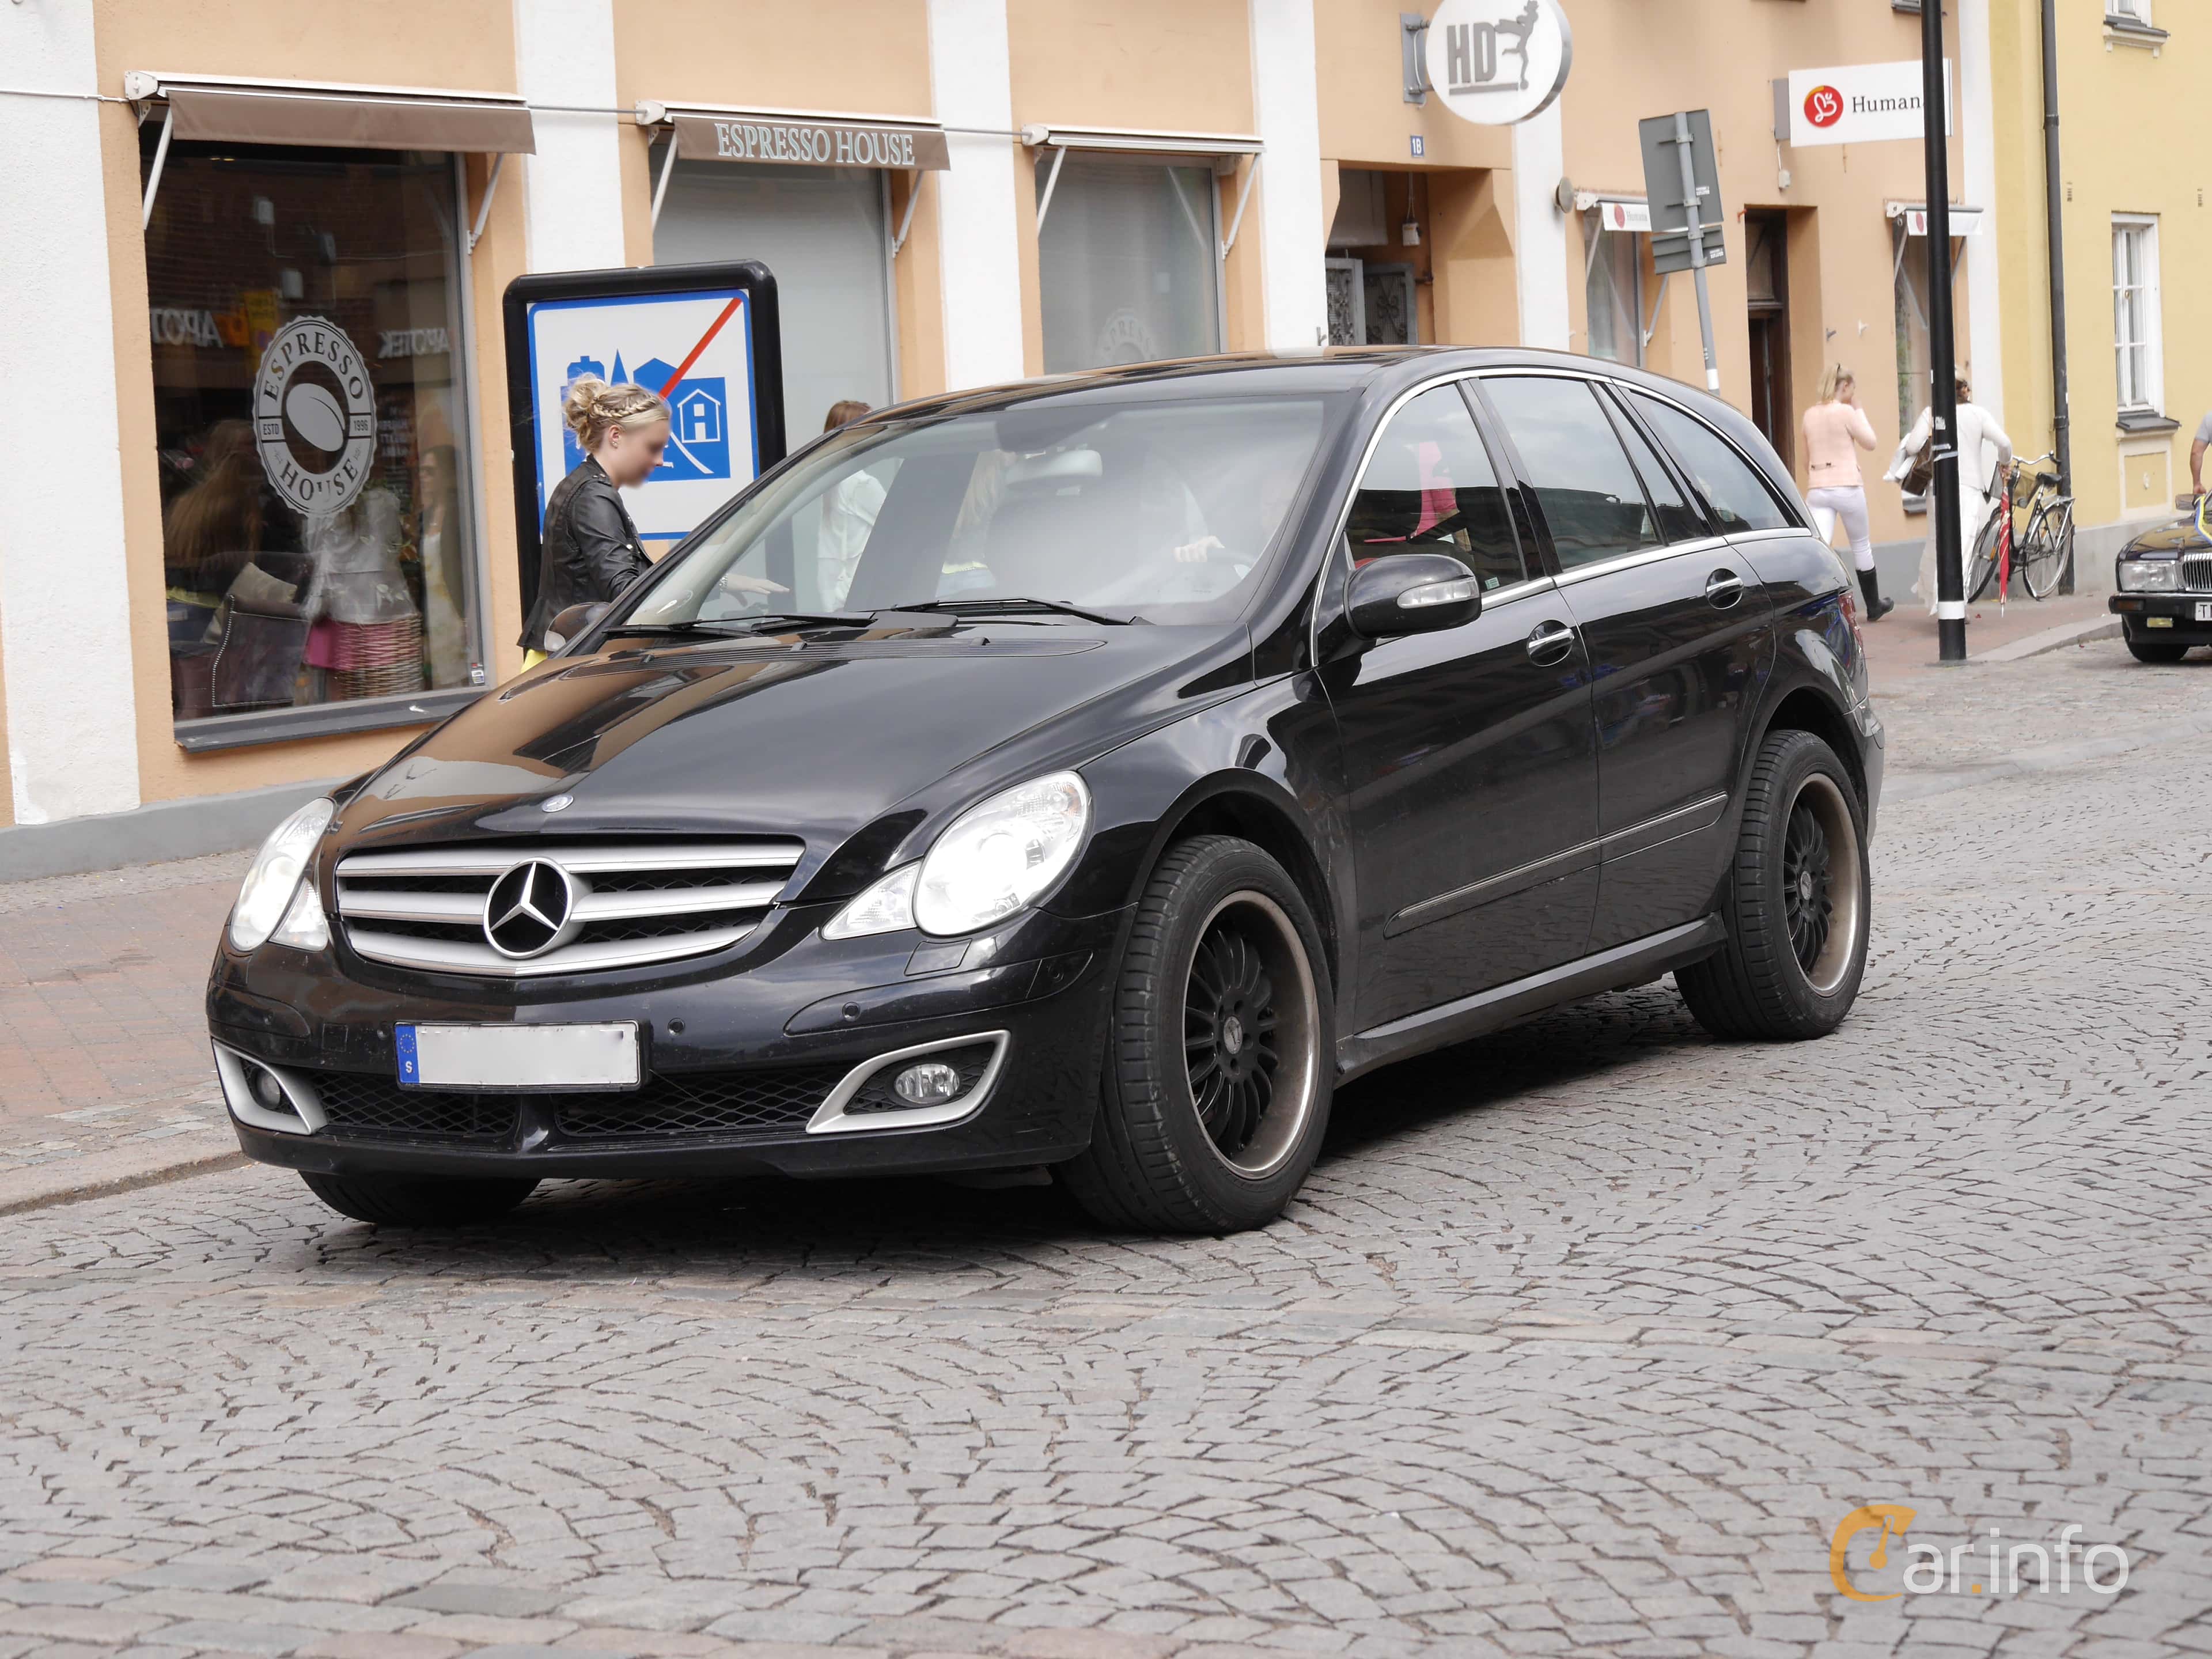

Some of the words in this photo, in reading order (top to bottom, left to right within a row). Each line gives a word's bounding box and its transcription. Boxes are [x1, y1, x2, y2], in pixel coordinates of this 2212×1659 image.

[1446, 21, 1497, 85] HD
[1853, 95, 1925, 113] Human
[714, 123, 831, 162] ESPRESSO
[835, 130, 915, 165] HOUSE
[263, 331, 363, 402] ESPRESSO
[263, 423, 279, 435] ESTD
[353, 419, 369, 432] 1996
[279, 458, 358, 503] HOUSE
[405, 1061, 413, 1074] S
